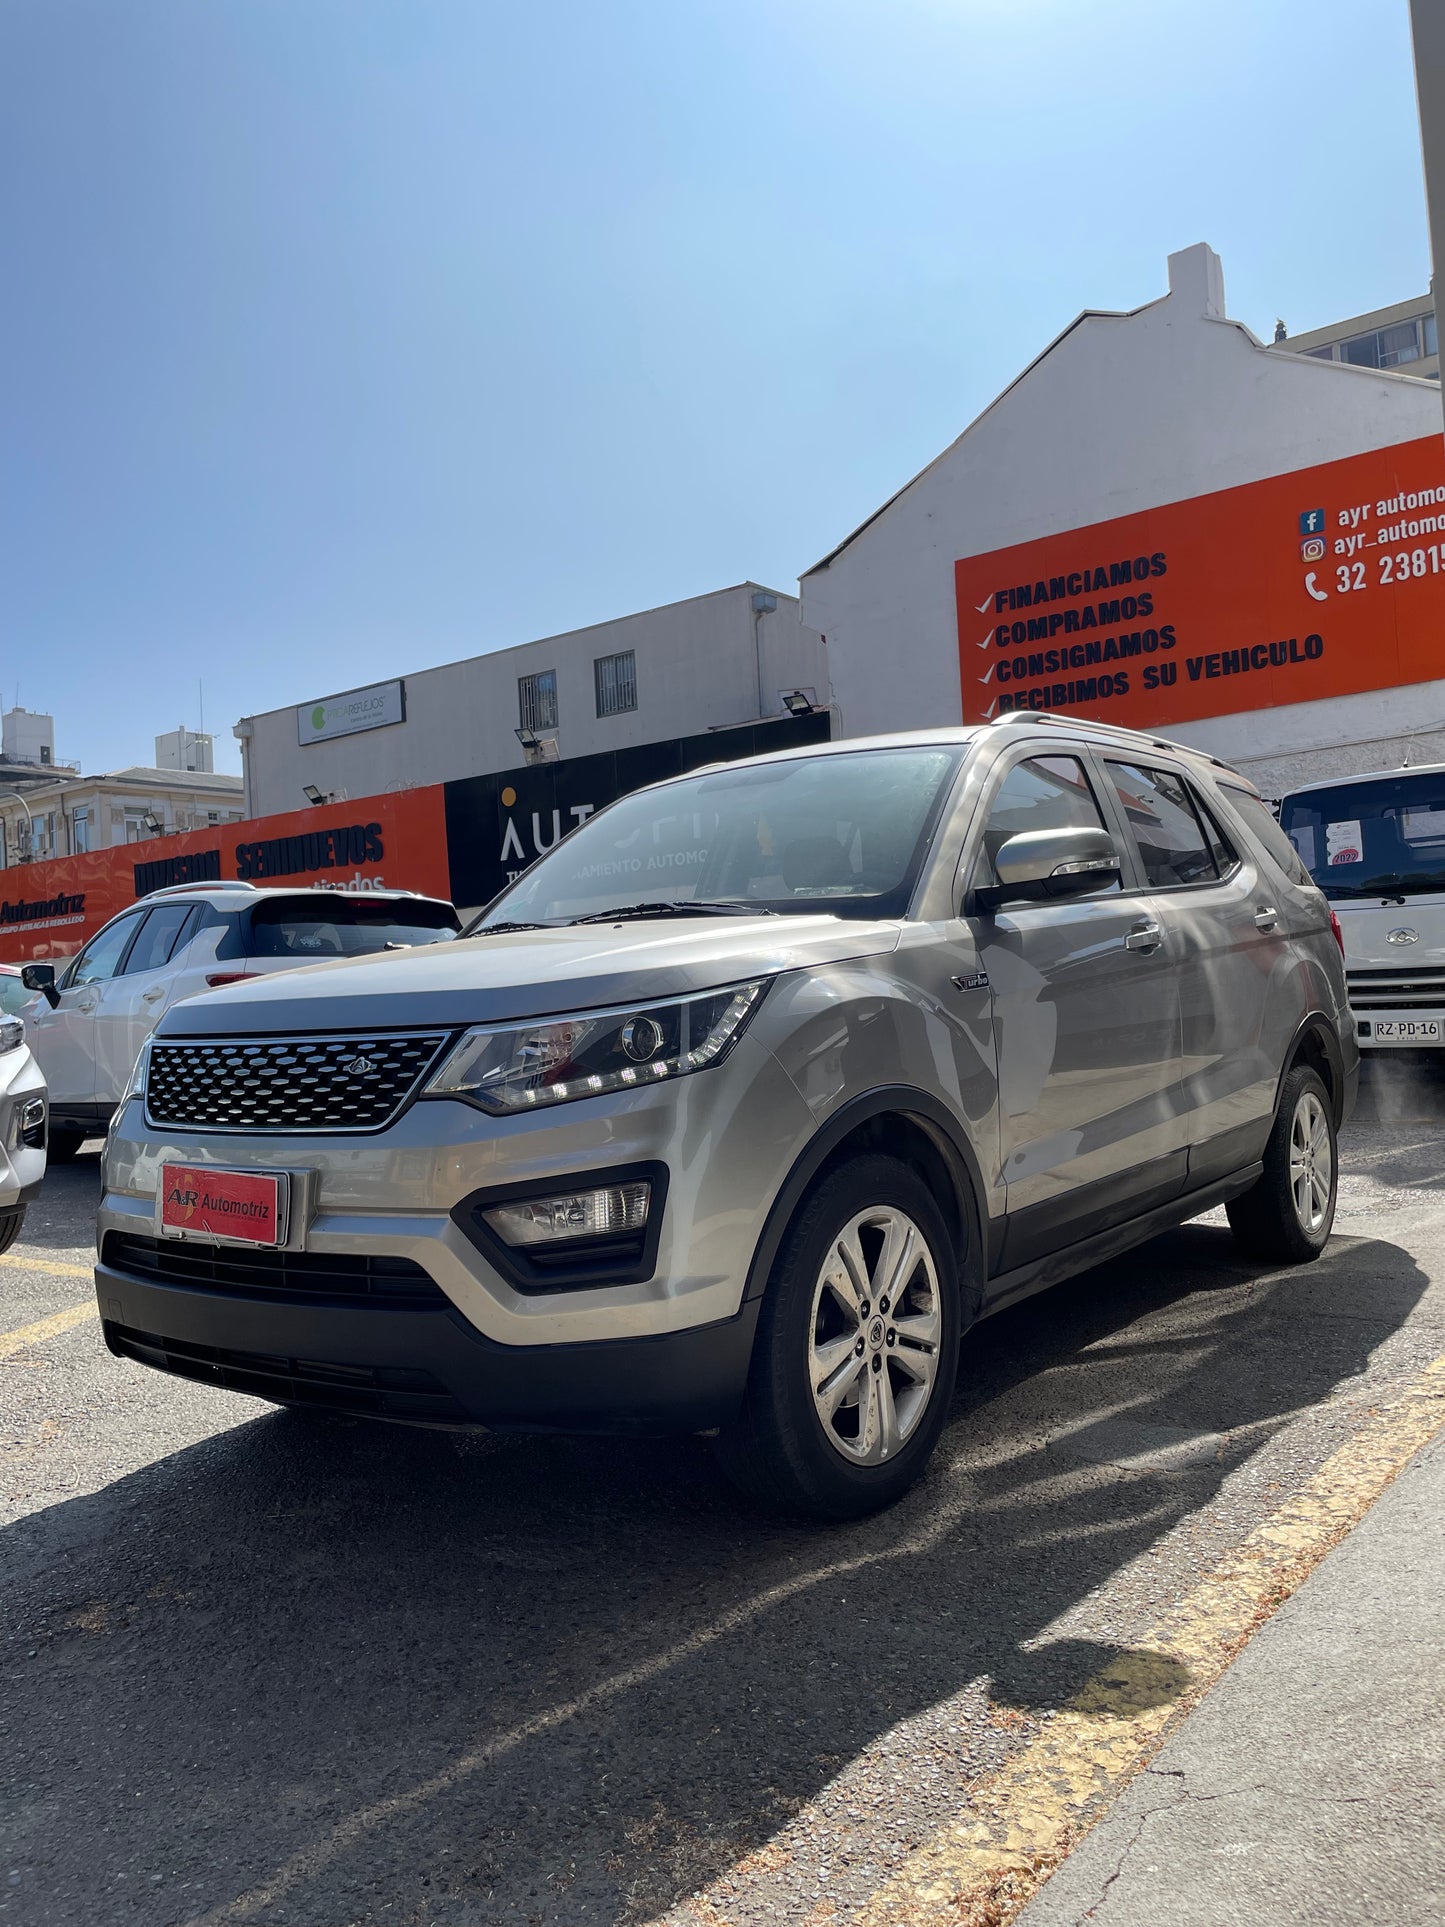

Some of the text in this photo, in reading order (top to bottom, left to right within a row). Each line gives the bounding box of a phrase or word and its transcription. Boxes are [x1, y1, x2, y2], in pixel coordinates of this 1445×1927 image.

[1338, 504, 1371, 529] ayr
[1376, 486, 1445, 516] automo
[1334, 514, 1445, 557] ayr_automo
[995, 552, 1167, 613] FINANCIAMOS
[1336, 562, 1367, 593] 32
[995, 593, 1154, 647] COMPRAMOS
[996, 625, 1176, 682] CONSIGNAMOS
[999, 634, 1323, 712] RECIBIMOS SU VEHICULO
[134, 823, 384, 897] DIVISION SEMINUEVOS
[1334, 853, 1357, 863] 2022
[0, 892, 85, 924] Automotriz
[960, 974, 988, 990] Turbo
[168, 1189, 199, 1208] A&R
[201, 1194, 269, 1219] Automotriz
